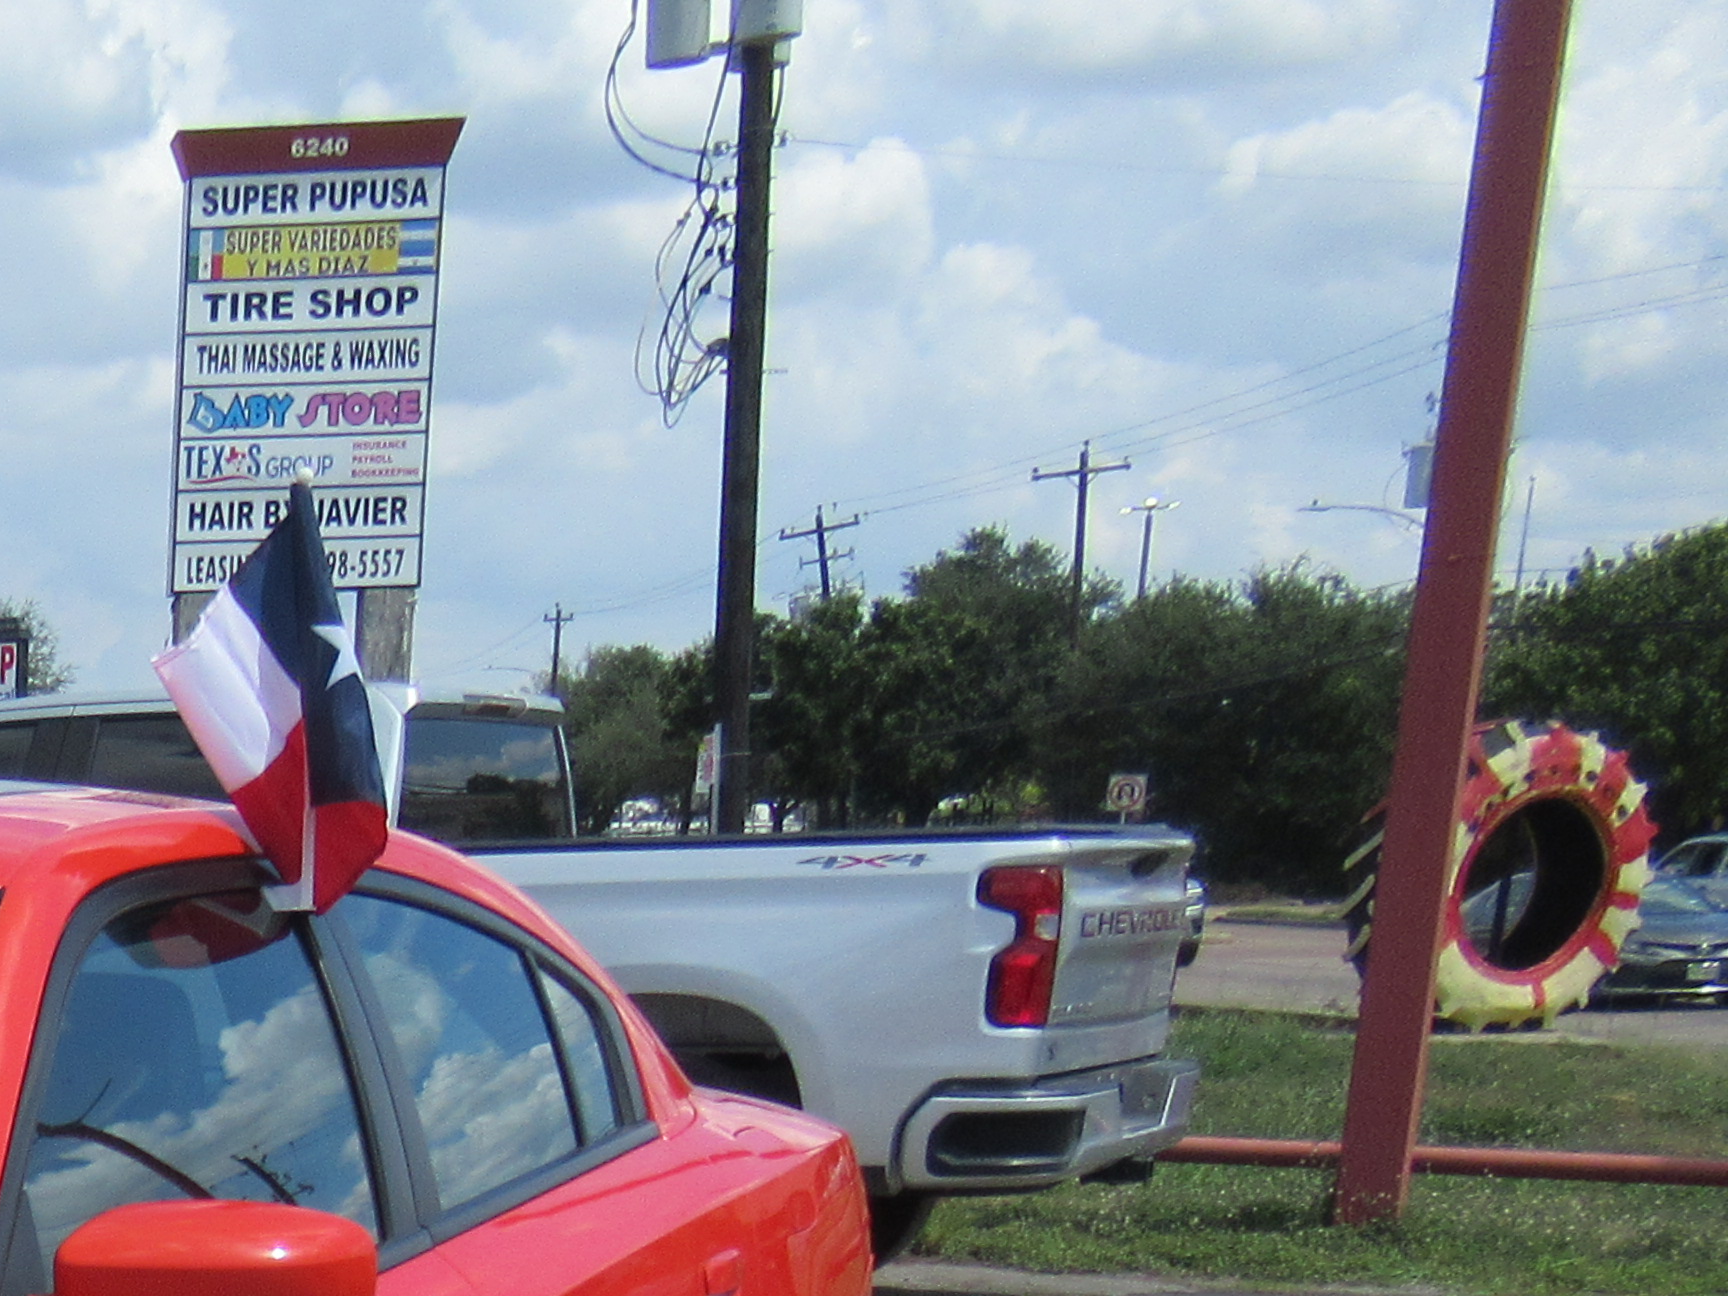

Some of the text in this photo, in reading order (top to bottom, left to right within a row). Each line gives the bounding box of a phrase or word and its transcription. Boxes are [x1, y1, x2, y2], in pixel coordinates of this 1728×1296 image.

[291, 137, 350, 159] 6240
[202, 176, 429, 218] SUPER PUPUSA
[226, 225, 397, 256] SUPER VARIEDADES
[247, 254, 370, 277] Y MAS DIAZ
[203, 285, 420, 323] TIRE SHOP
[197, 337, 421, 375] THAI MASSAGE & WAXING
[187, 389, 423, 434] BABY STORE
[265, 455, 335, 479] GROUP
[188, 500, 255, 532] HAIR
